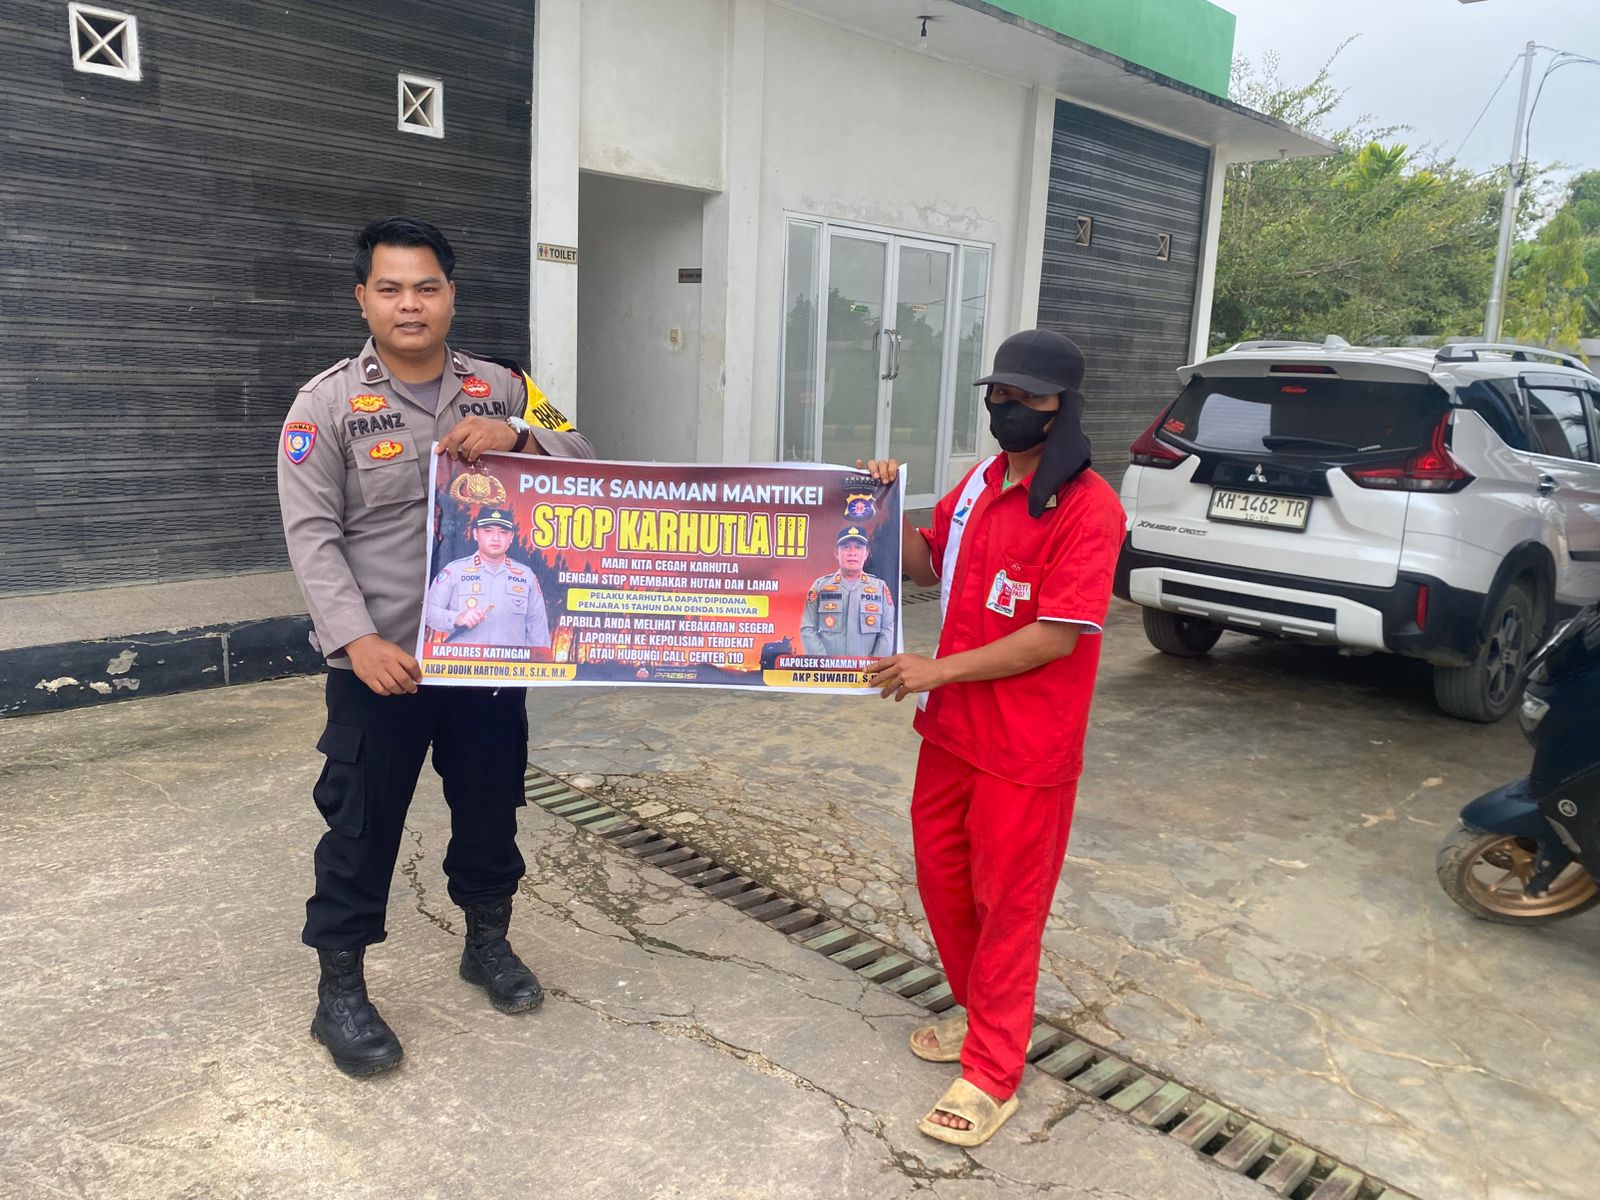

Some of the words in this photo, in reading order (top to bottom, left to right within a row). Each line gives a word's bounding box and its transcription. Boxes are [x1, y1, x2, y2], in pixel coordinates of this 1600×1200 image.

[549, 248, 577, 260] TOILET
[460, 401, 506, 417] POLRI
[347, 412, 405, 437] FRANZ
[519, 473, 605, 497] POLSEK
[609, 478, 717, 502] SANAMAN
[722, 484, 823, 505] MANTIKEI
[1216, 492, 1237, 510] KH
[1239, 495, 1279, 515] 1462
[1285, 500, 1305, 517] TR
[531, 502, 615, 550] STOP
[617, 508, 773, 557] KARHUTLA
[775, 514, 809, 558] !!!
[601, 557, 628, 570] MARI
[631, 559, 652, 571] KITA
[655, 559, 687, 572] CEGAH
[690, 561, 739, 574] KARHUTLA
[507, 575, 527, 583] POLRI
[558, 572, 598, 584] DENGAN
[601, 574, 627, 586] STOP
[629, 575, 688, 588] MEMBAKAR
[690, 578, 722, 590] HUTAN
[724, 579, 744, 590] DAN
[747, 580, 779, 591] LAHAN
[590, 591, 624, 600] PELAKU
[626, 593, 672, 602] KARHUTLA
[674, 595, 703, 603] DAPAT
[704, 596, 747, 605] DIPIDANA
[578, 601, 619, 610] PENJARA
[622, 602, 630, 610] 15
[632, 603, 661, 612] TAHUN
[663, 604, 683, 612] DAN
[684, 605, 714, 614] DENDA
[715, 606, 724, 614] 15
[725, 607, 758, 615] MILYAR
[559, 615, 601, 628] APABILA
[604, 617, 631, 629] ANDA
[633, 619, 676, 631] MELIHAT
[679, 620, 736, 633] KEBAKARAN
[738, 622, 775, 634] SEGERA
[579, 632, 631, 644] LAPORKAN
[634, 634, 647, 645] KE
[649, 634, 705, 647] KEPOLISIAN
[707, 637, 755, 648] TERDEKAT
[432, 645, 481, 658] KAPOLRES
[483, 647, 531, 660] KATINGAN
[589, 647, 615, 659] ATAU
[617, 649, 661, 661] HUBUNGI
[662, 650, 686, 662] CALL
[689, 652, 725, 663] CENTER
[728, 652, 744, 664] 110
[424, 663, 446, 674] AKBP
[447, 664, 473, 675] DODIK
[473, 665, 511, 677] HARTONO,
[780, 657, 818, 668] KAPOLSEK
[819, 658, 857, 669] SANAMAN
[792, 672, 812, 682] AKP
